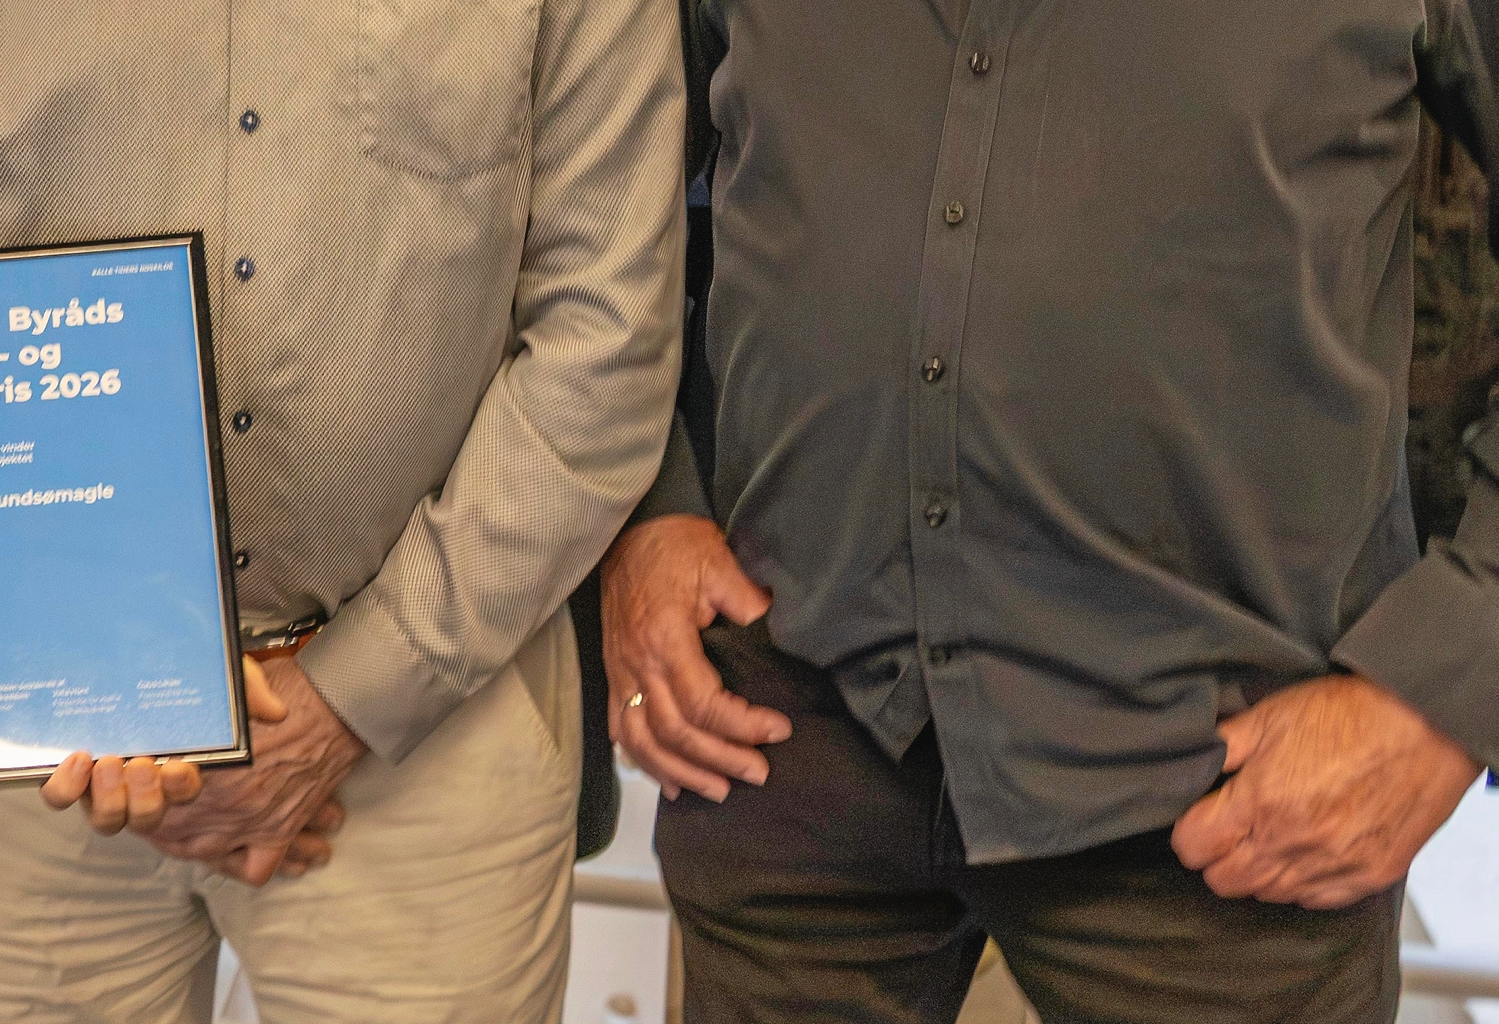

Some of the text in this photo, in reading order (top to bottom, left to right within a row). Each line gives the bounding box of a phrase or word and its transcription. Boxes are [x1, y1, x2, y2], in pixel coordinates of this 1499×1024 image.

[9, 297, 124, 335] Byråds
[18, 342, 62, 370] og
[40, 368, 121, 400] 2026
[0, 441, 35, 453] vinder
